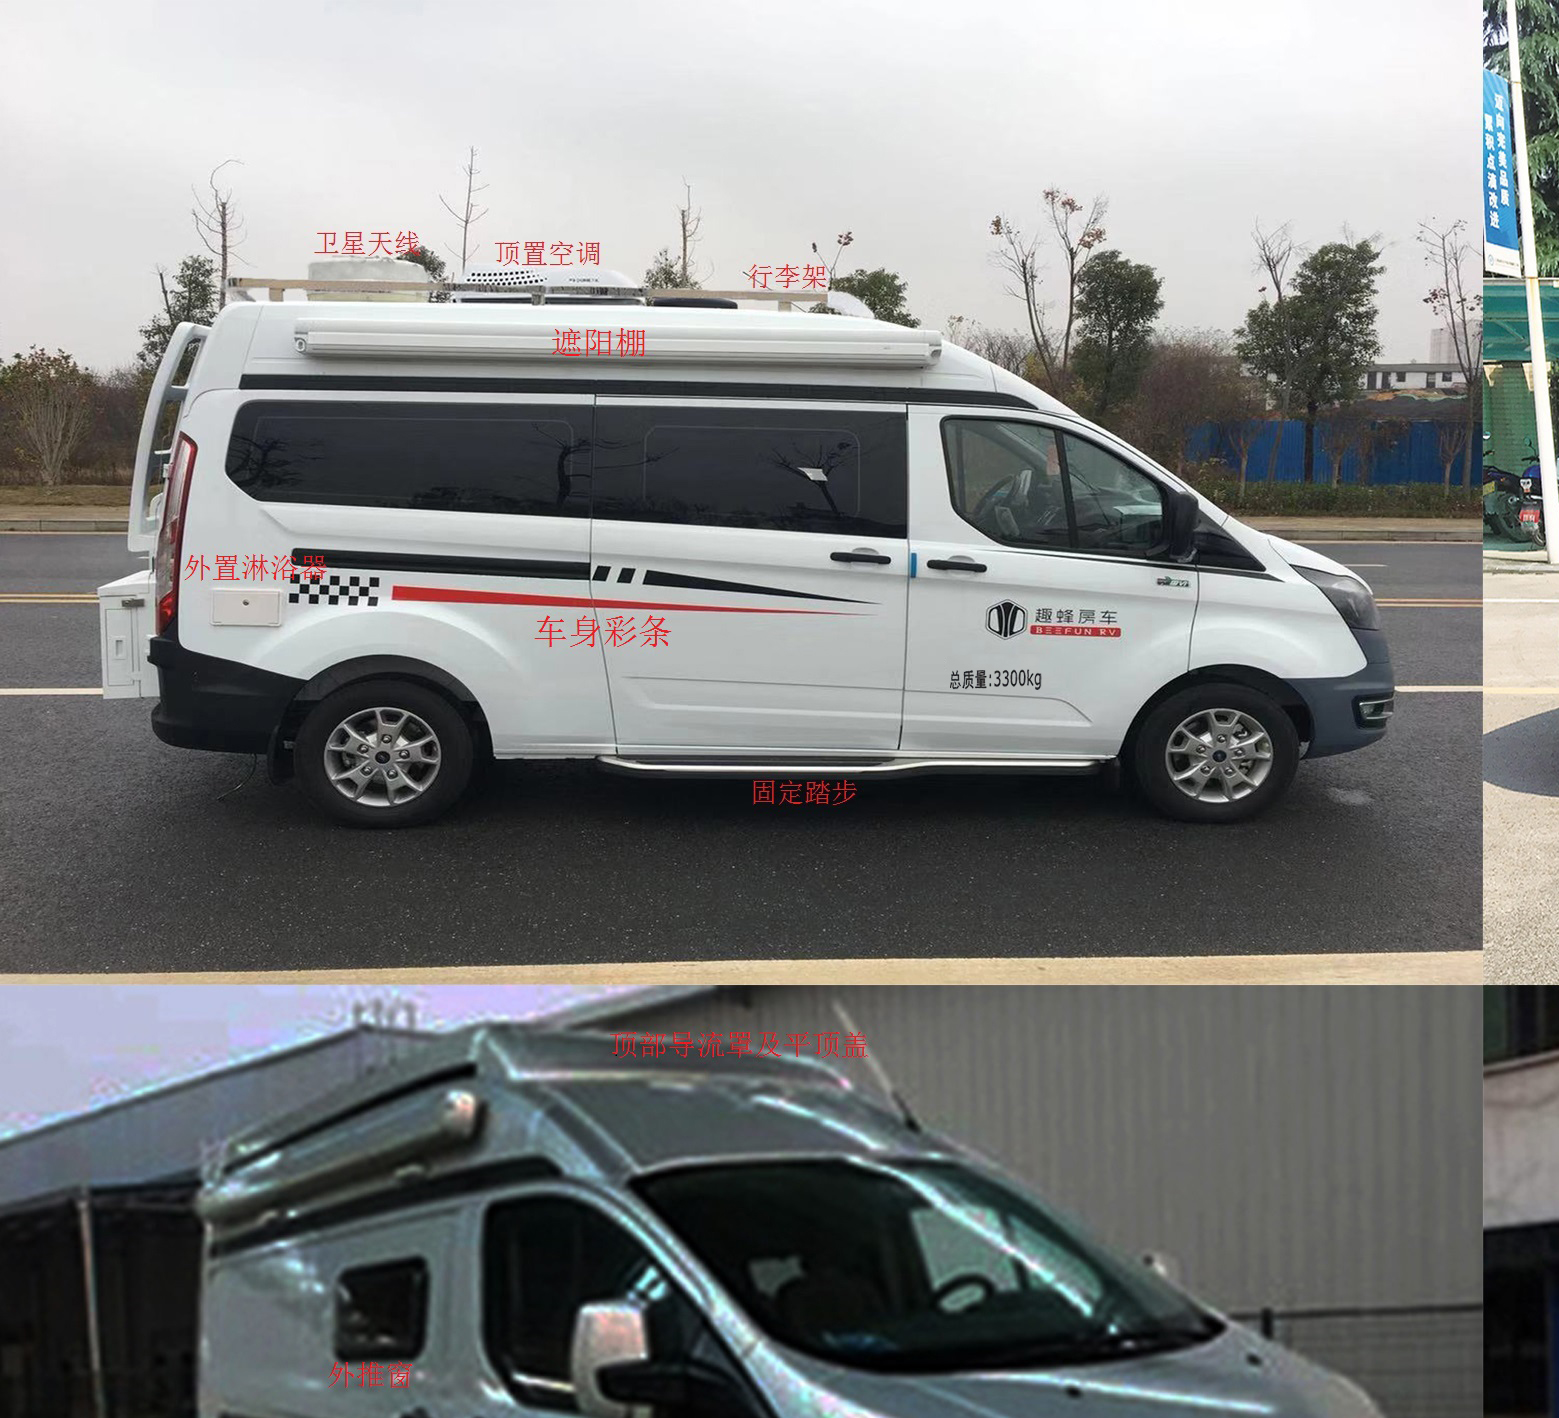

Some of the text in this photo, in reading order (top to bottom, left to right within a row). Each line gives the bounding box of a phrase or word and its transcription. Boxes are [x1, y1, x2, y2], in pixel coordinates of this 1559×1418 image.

[1035, 608, 1118, 625] 趣蜂房车
[1099, 628, 1117, 637] RV
[949, 669, 1042, 691] 总质量:3300kg
